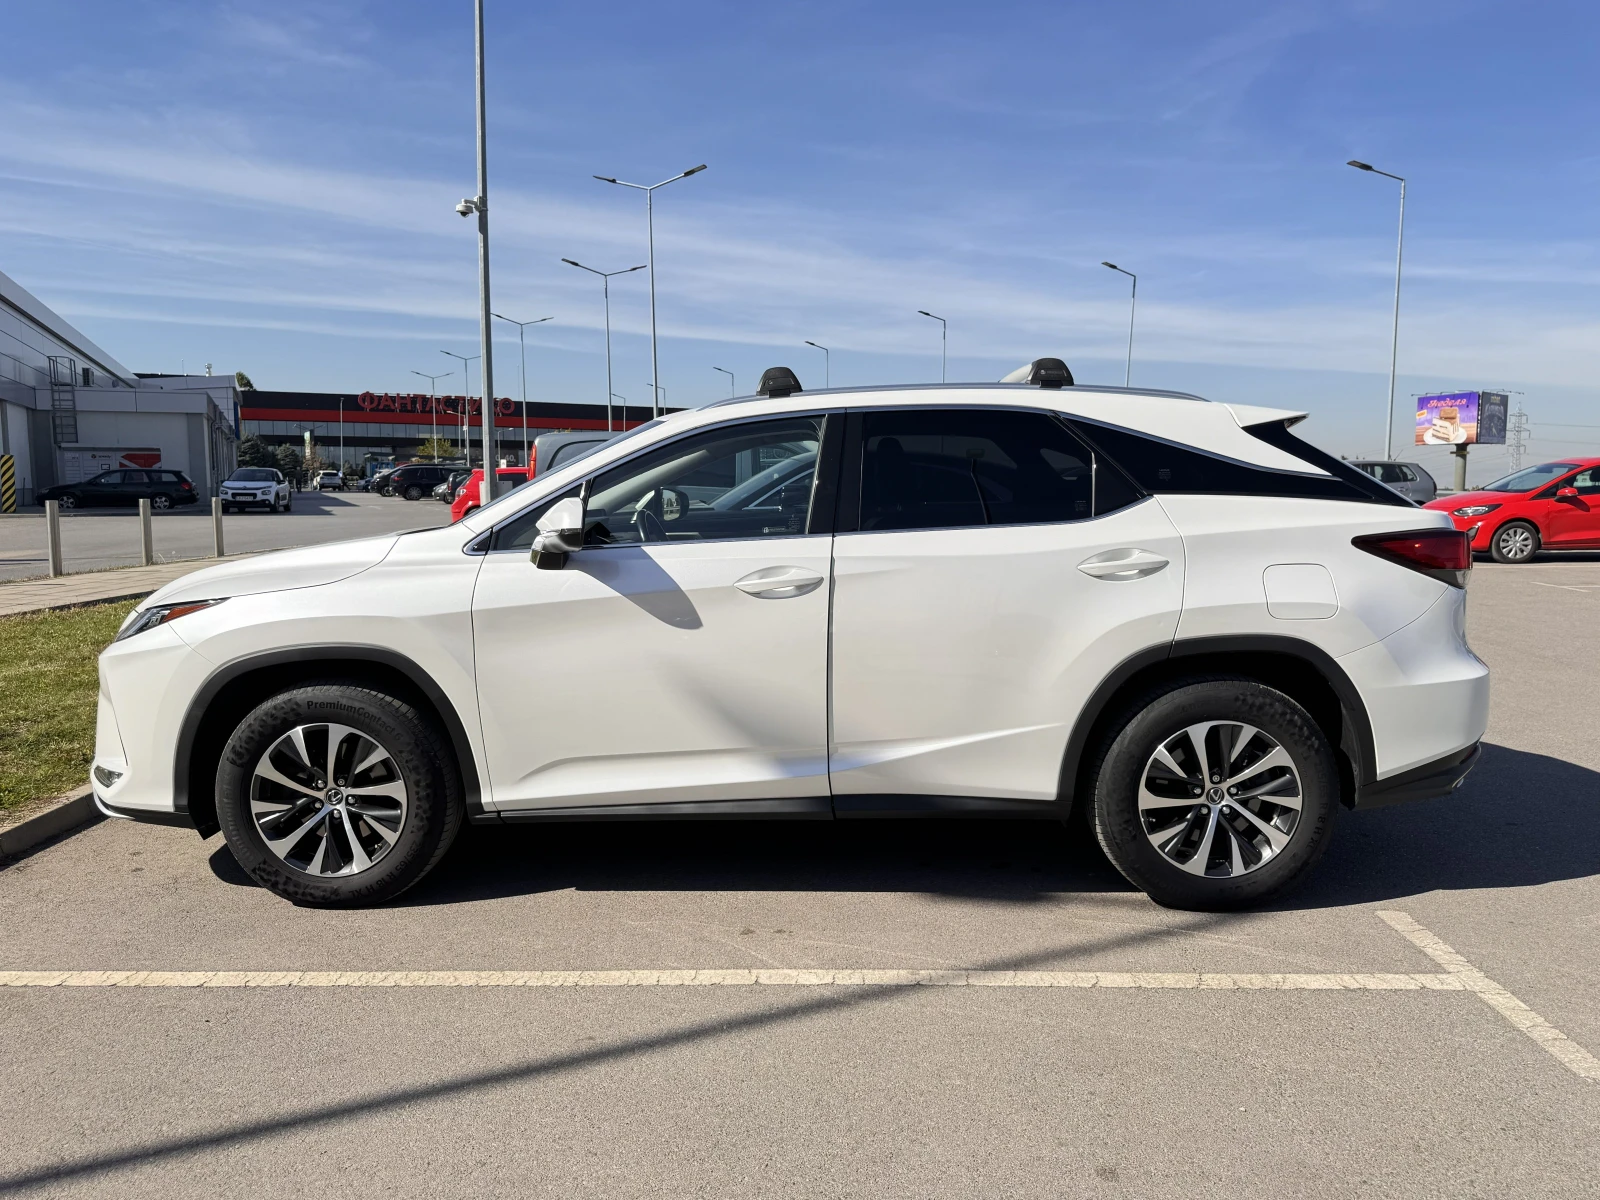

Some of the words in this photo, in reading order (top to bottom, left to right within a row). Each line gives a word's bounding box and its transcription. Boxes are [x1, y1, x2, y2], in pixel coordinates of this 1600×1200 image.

[306, 699, 397, 734] PremiumContact
[392, 730, 404, 742] 6
[393, 839, 422, 874] 235/65
[349, 887, 364, 899] XL
[364, 883, 375, 895] H
